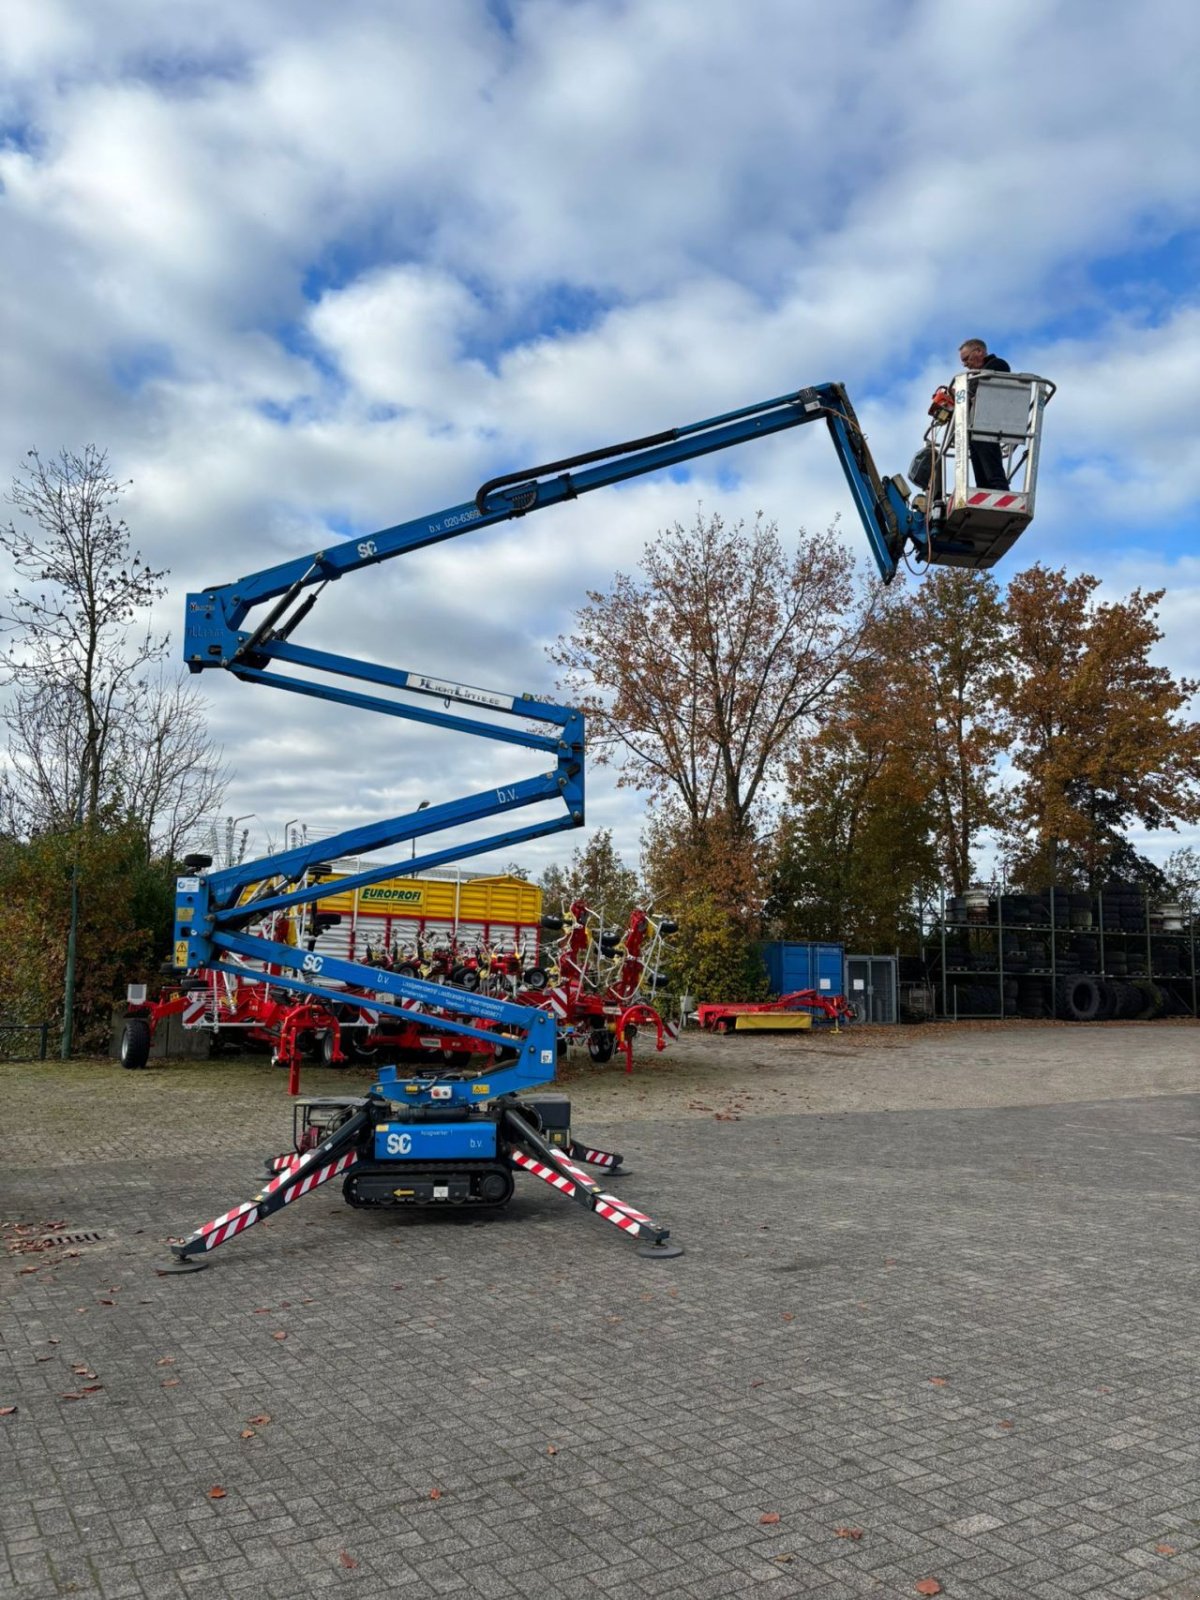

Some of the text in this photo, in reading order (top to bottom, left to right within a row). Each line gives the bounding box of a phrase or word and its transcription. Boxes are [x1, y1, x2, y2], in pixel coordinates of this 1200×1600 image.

[496, 787, 519, 804] b.v.
[362, 888, 421, 900] EUROPROFI
[386, 1133, 412, 1154] SC
